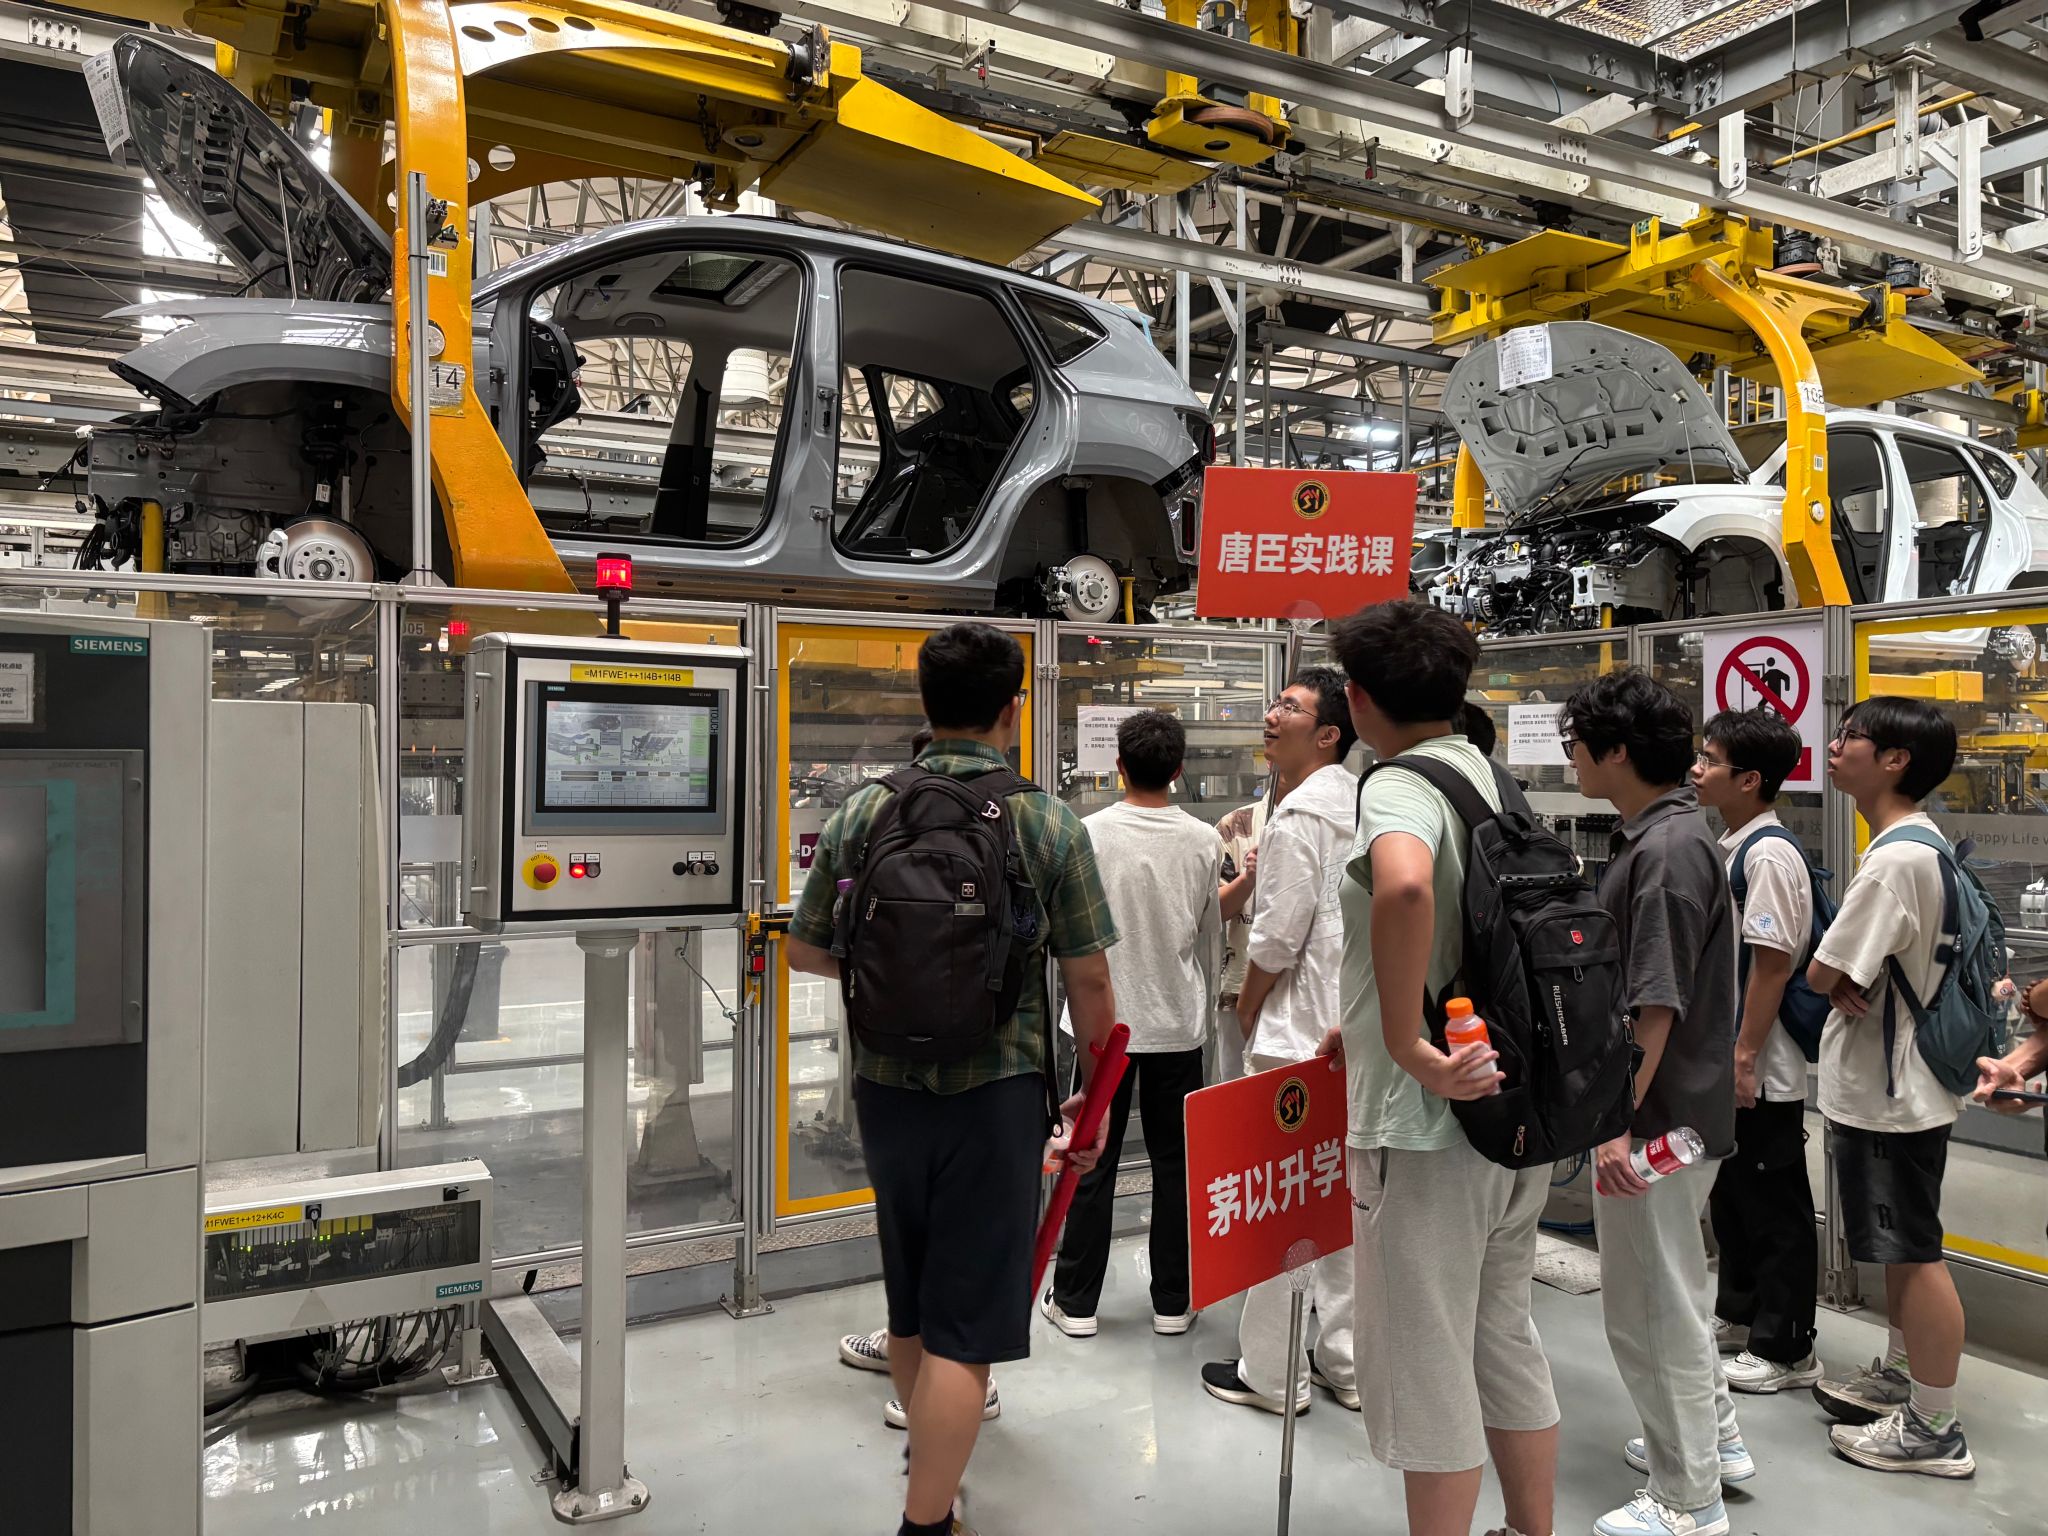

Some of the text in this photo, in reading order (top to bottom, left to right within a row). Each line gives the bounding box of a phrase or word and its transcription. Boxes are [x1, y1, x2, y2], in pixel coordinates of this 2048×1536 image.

[431, 365, 460, 390] 14
[1217, 531, 1394, 577] 唐臣实践课
[74, 639, 143, 652] SIEMENS
[710, 709, 719, 735] TOUCH
[1966, 830, 2008, 846] Happy
[1552, 985, 1569, 1046] RUISHISABER
[1206, 1137, 1350, 1238] 茅以升学
[439, 1282, 480, 1296] SIEMENS
